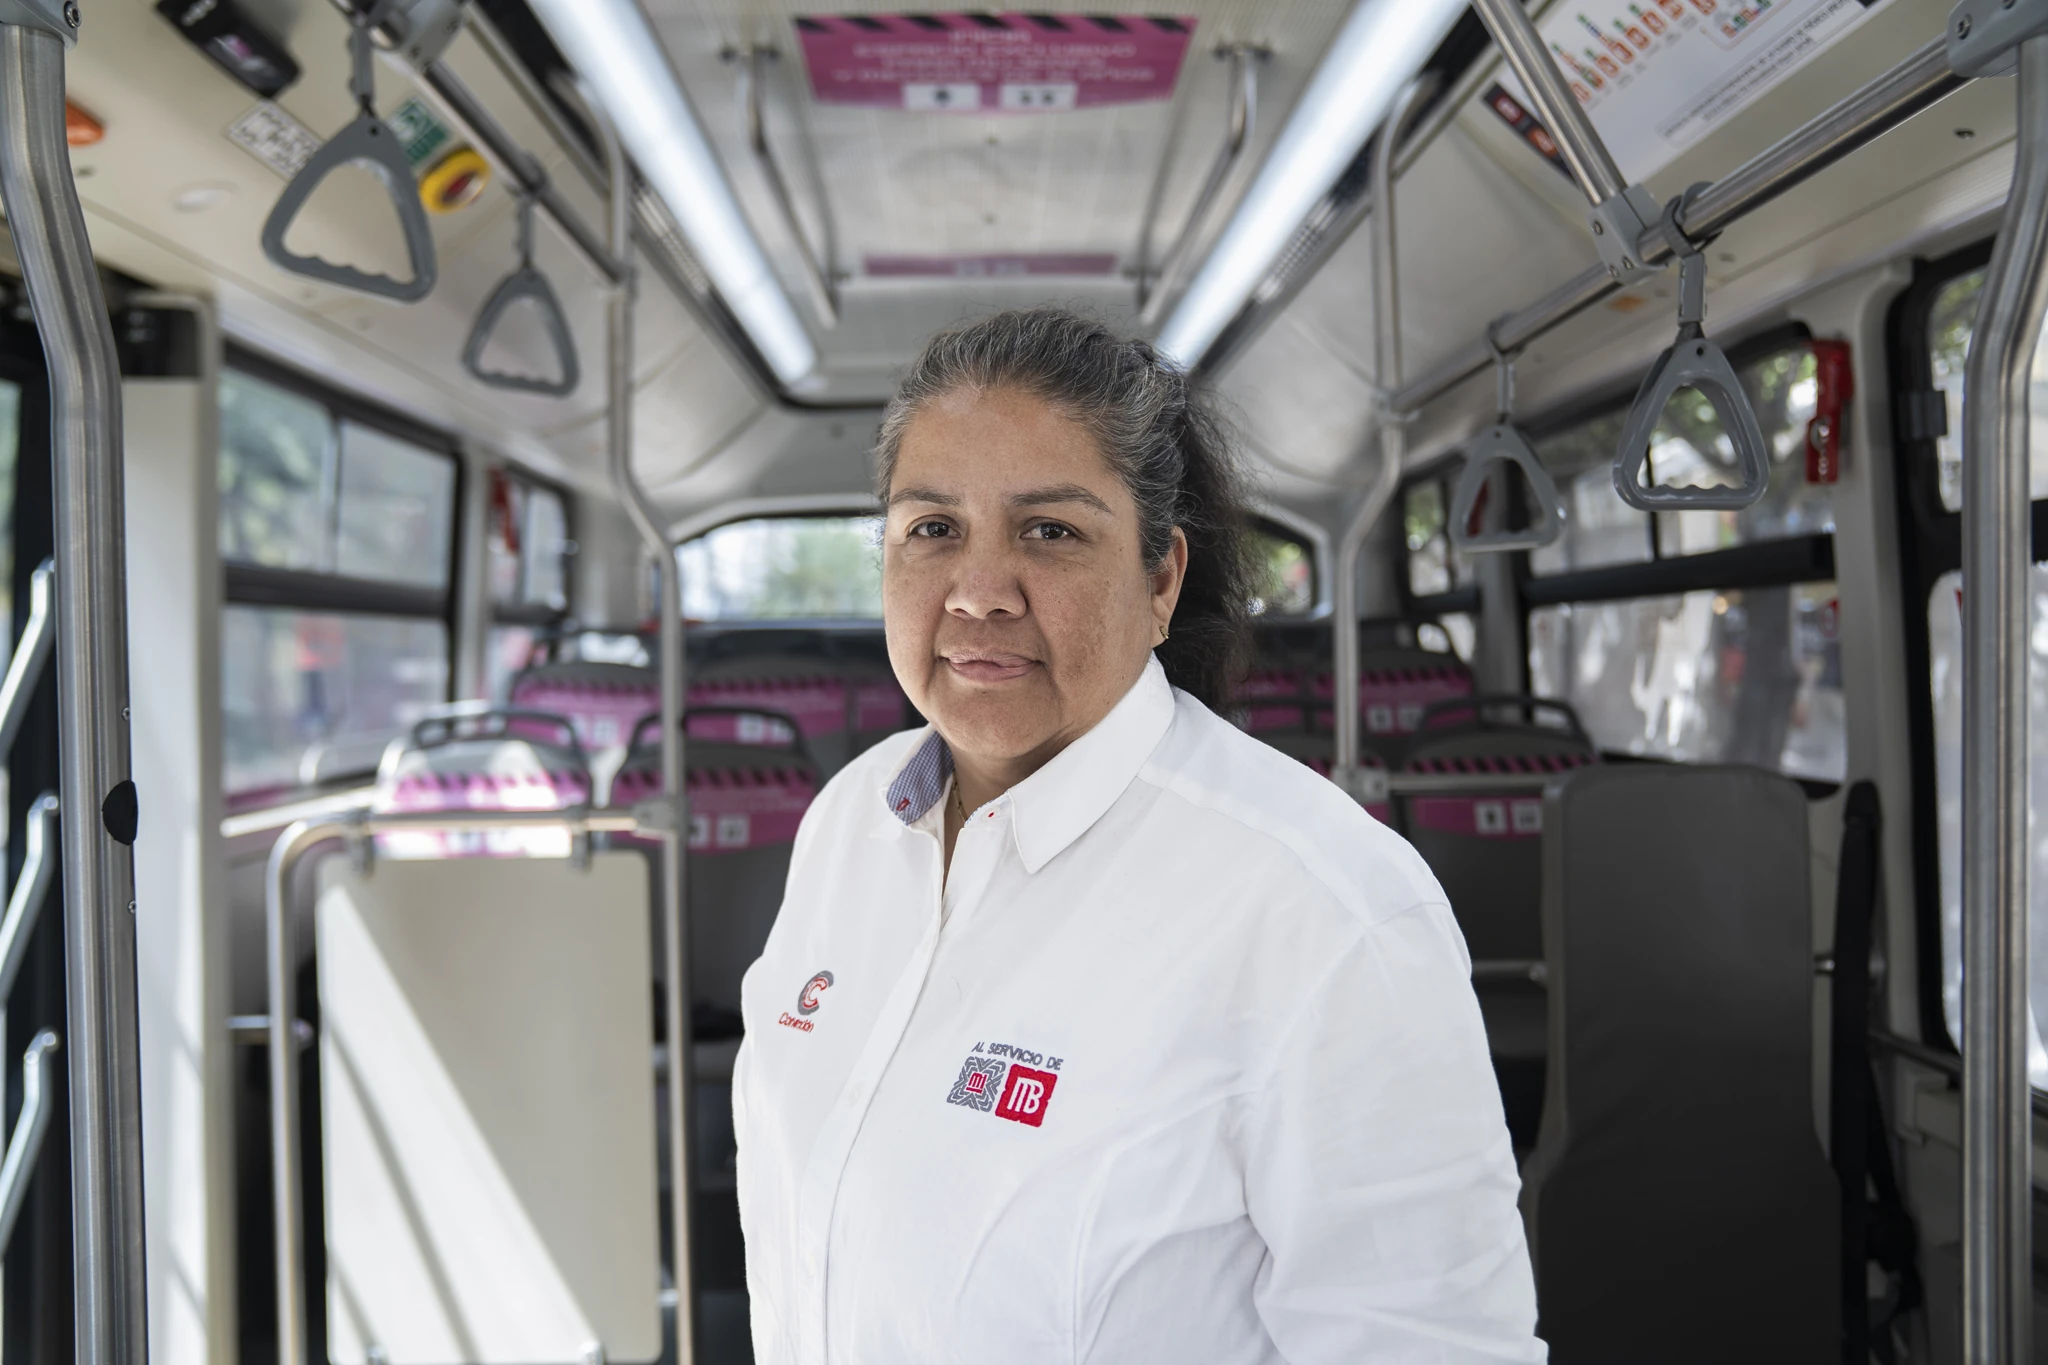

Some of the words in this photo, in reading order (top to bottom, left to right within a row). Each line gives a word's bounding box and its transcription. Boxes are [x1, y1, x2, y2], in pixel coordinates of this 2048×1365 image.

[971, 1042, 985, 1052] AL
[988, 1043, 1043, 1066] SERVICIO
[1046, 1057, 1064, 1070] DE
